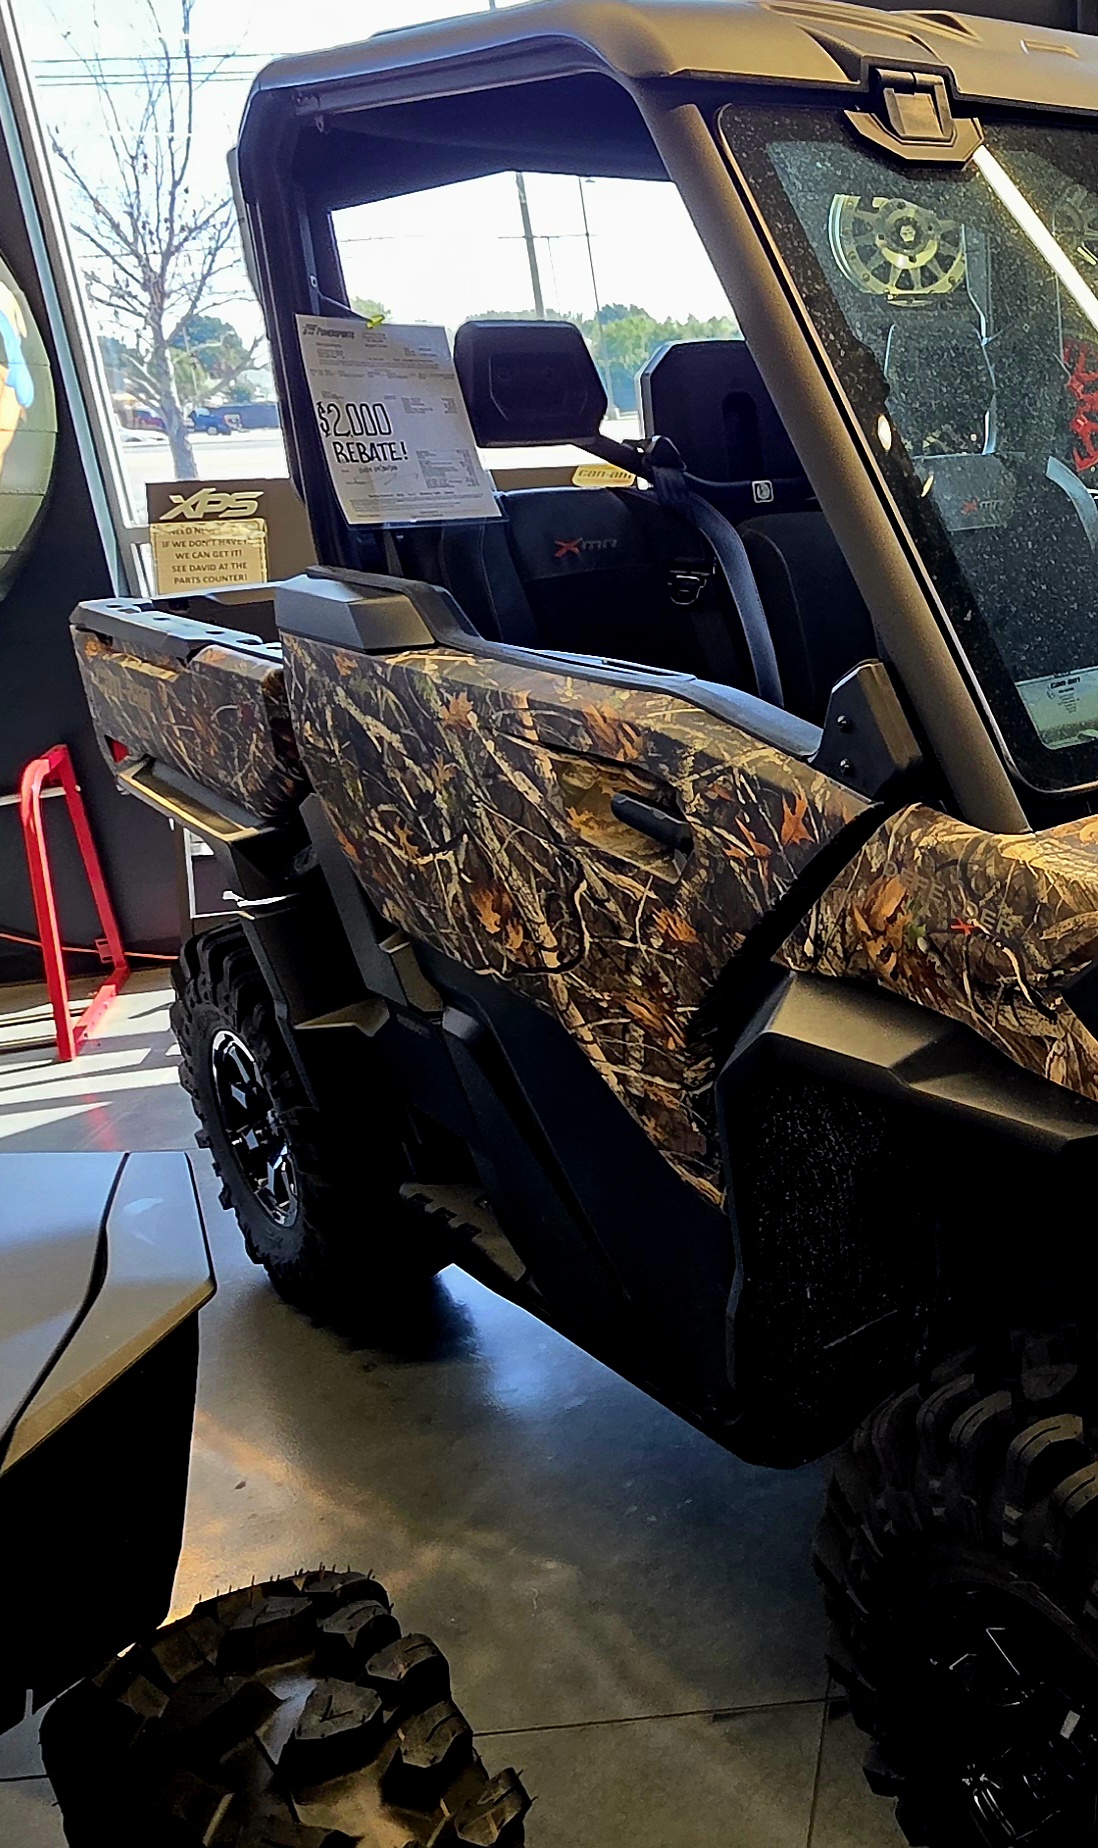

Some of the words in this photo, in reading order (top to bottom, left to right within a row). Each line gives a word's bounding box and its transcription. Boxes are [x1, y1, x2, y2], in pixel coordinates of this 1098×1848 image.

[332, 441, 408, 463] REBATE!
[159, 487, 264, 520] XPS
[172, 540, 186, 548] WE
[192, 551, 210, 559] CAN
[172, 565, 186, 573] SEE
[189, 564, 216, 572] DAVID
[219, 563, 228, 571] AT
[231, 562, 247, 570] THE
[174, 577, 200, 585] PARTS
